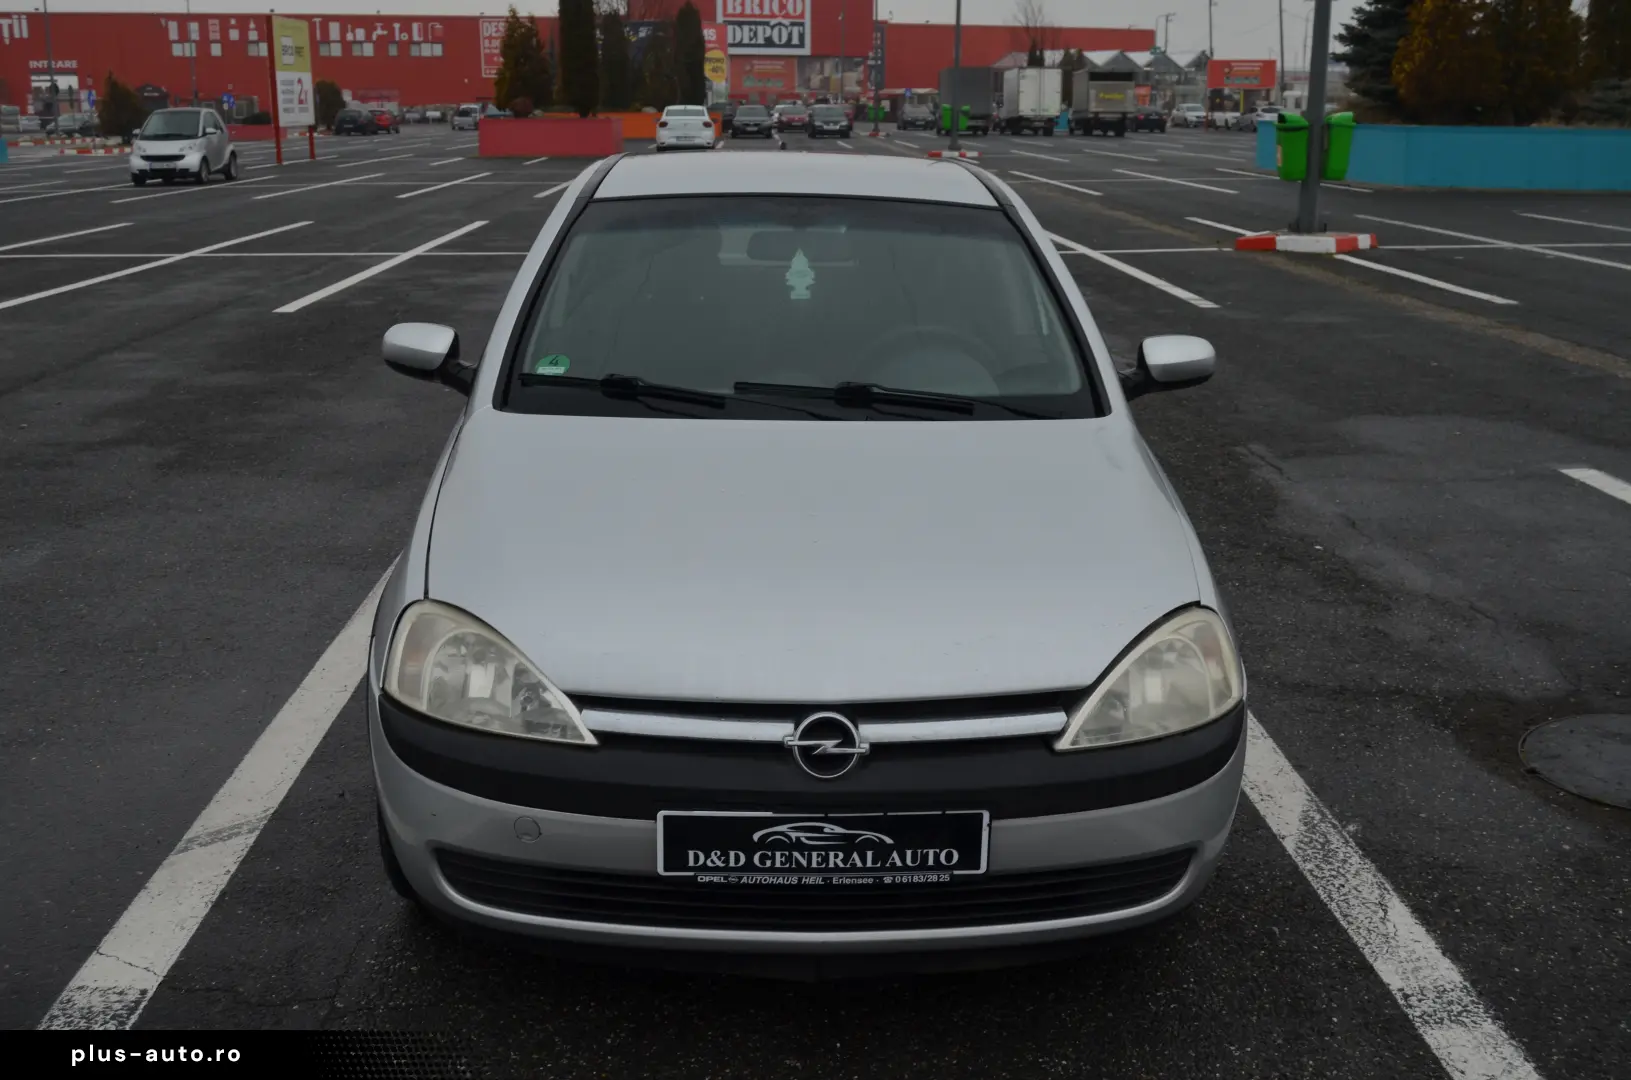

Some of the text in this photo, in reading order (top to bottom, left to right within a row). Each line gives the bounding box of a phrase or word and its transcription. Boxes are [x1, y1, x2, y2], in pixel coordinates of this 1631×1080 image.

[726, 0, 804, 16] BRICO
[688, 848, 959, 868] D&D GENERAL AUTO
[697, 875, 728, 883] OPEL
[740, 876, 798, 885] AUTOHAUS
[801, 876, 825, 885] HEIL
[832, 876, 874, 885] Erlensee
